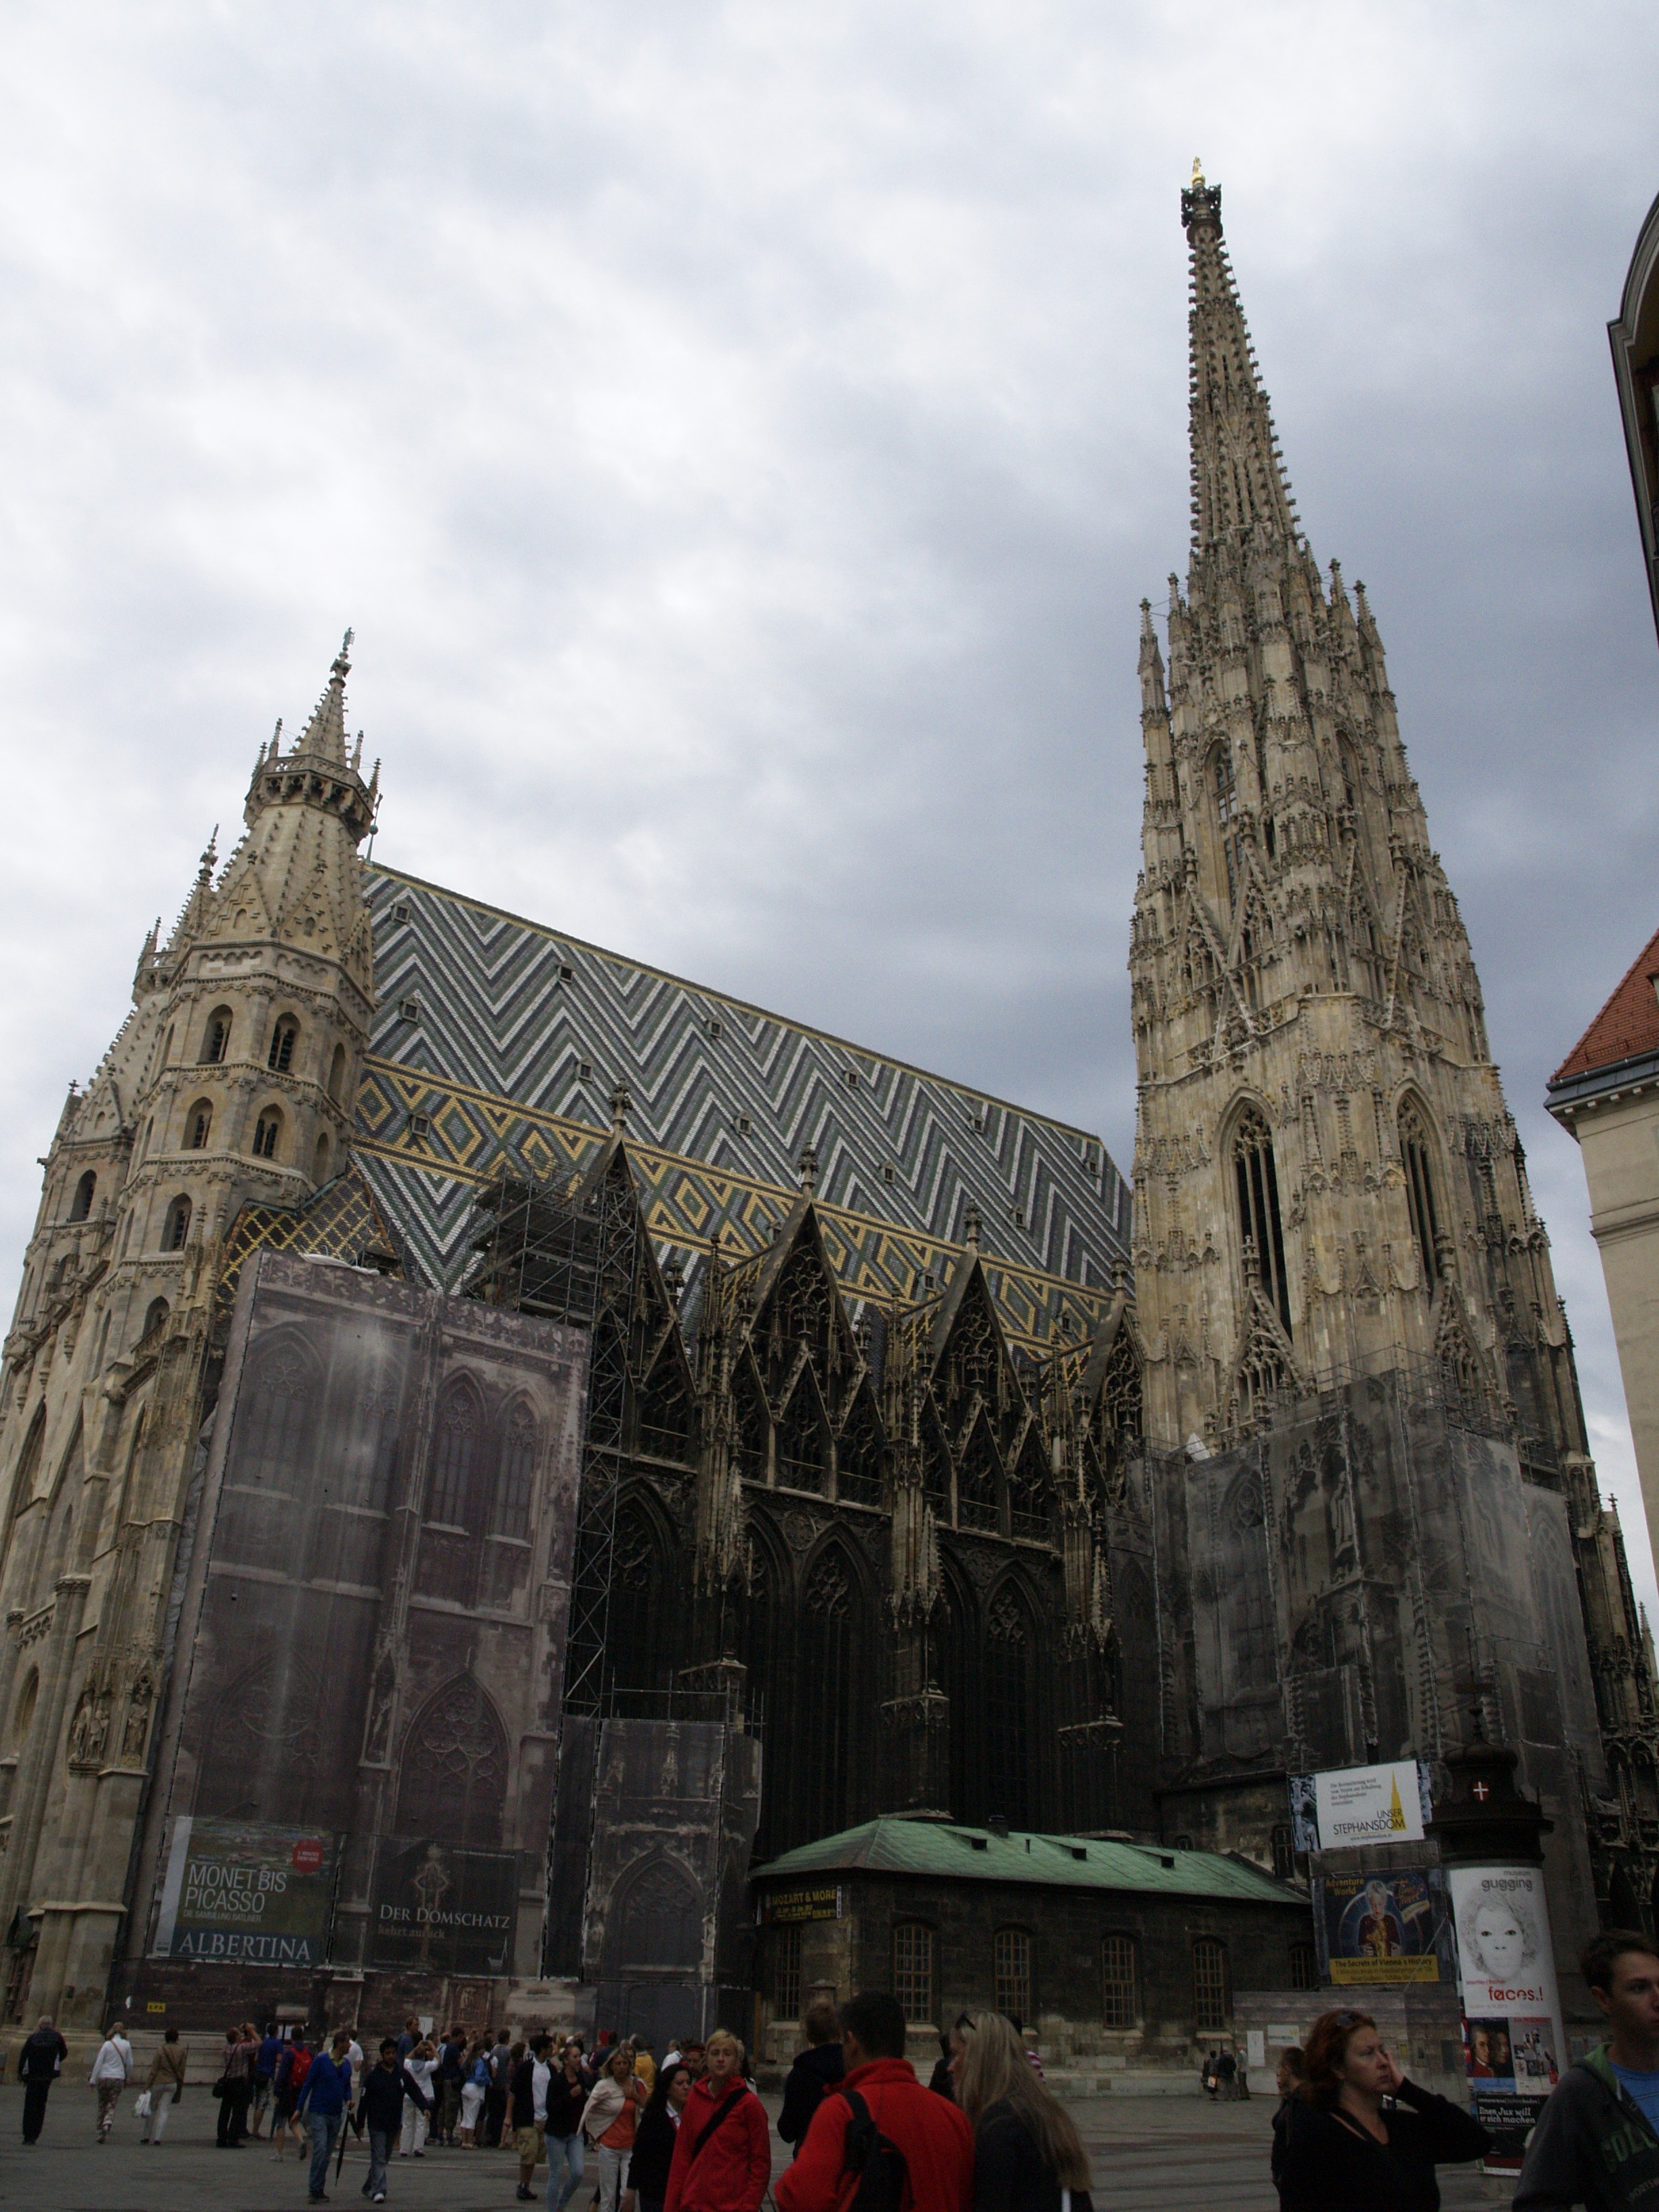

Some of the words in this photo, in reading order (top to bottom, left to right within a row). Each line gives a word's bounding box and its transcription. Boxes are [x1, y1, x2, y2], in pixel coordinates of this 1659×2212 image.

[1376, 1808, 1402, 1819] UNSER
[1333, 1818, 1406, 1835] STEPHANSDOM
[188, 1864, 257, 1889] MONET
[258, 1870, 287, 1892] BIS
[1325, 1878, 1365, 1888] Adventure
[1481, 1877, 1533, 1891] gugging
[184, 1887, 266, 1913] PICASSO
[1333, 1886, 1357, 1897] World
[380, 1904, 411, 1921] DER
[416, 1907, 510, 1929] DOMSCHATZ
[178, 1932, 311, 1961] ALBERTINA
